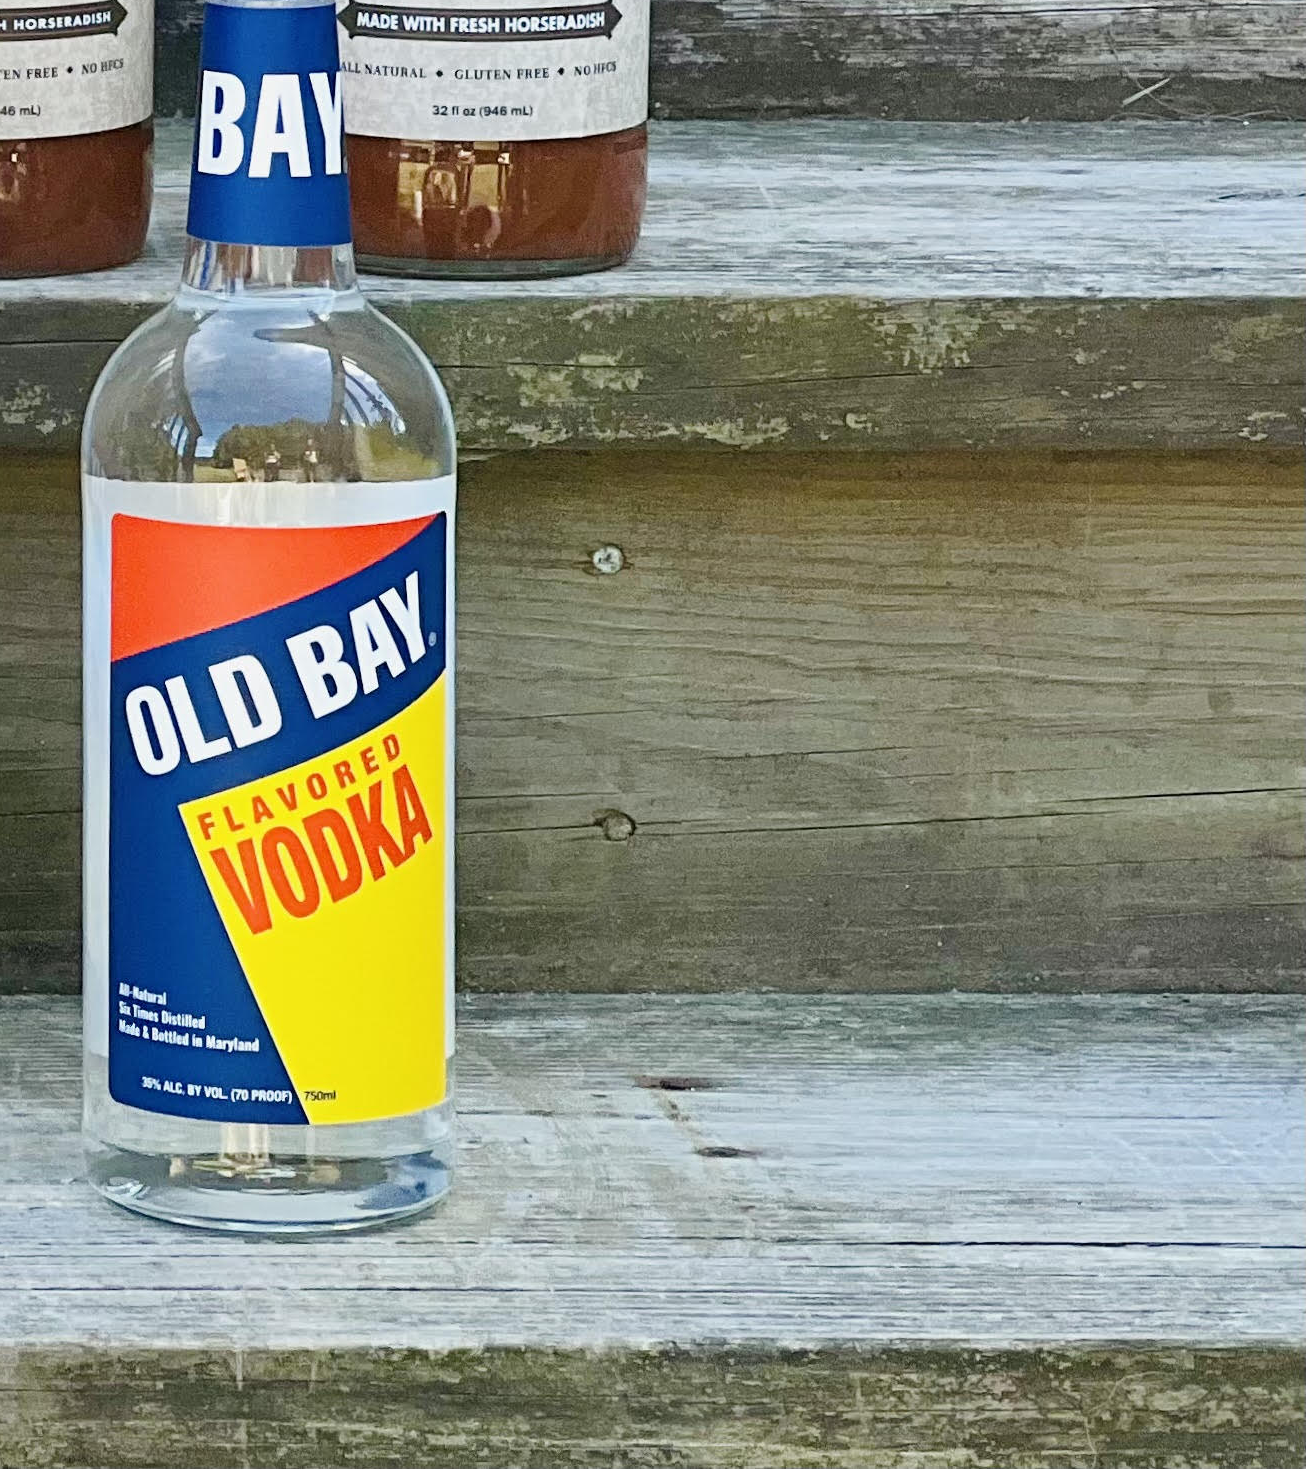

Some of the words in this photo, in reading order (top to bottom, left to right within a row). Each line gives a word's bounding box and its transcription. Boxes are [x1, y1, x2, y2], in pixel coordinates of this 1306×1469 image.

[13, 11, 111, 30] HORSERADISH
[357, 12, 399, 29] MADE
[403, 15, 445, 31] WITH
[450, 18, 500, 33] FRESH
[505, 12, 605, 33] HORSERADISH
[27, 67, 58, 78] FREE
[81, 62, 97, 74] NO
[197, 70, 343, 178] BAY
[125, 653, 283, 777] OLD
[286, 570, 428, 720] BAY
[197, 733, 402, 842] FLAVORED
[209, 763, 435, 936] VODKA
[119, 982, 166, 1005] All-Natural
[119, 1001, 131, 1015] Six
[133, 1005, 158, 1023] Times
[161, 1010, 205, 1029] Distilled
[119, 1019, 140, 1038] Made
[143, 1025, 149, 1039] &
[152, 1027, 189, 1046] Bottled
[192, 1033, 203, 1047] in
[206, 1035, 259, 1053] Maryland
[142, 1076, 161, 1090] 35%
[164, 1078, 184, 1095] ALC.
[188, 1083, 201, 1096] BY
[204, 1085, 228, 1100] VOL.
[231, 1089, 248, 1102] (70
[251, 1090, 292, 1104] PROOF)
